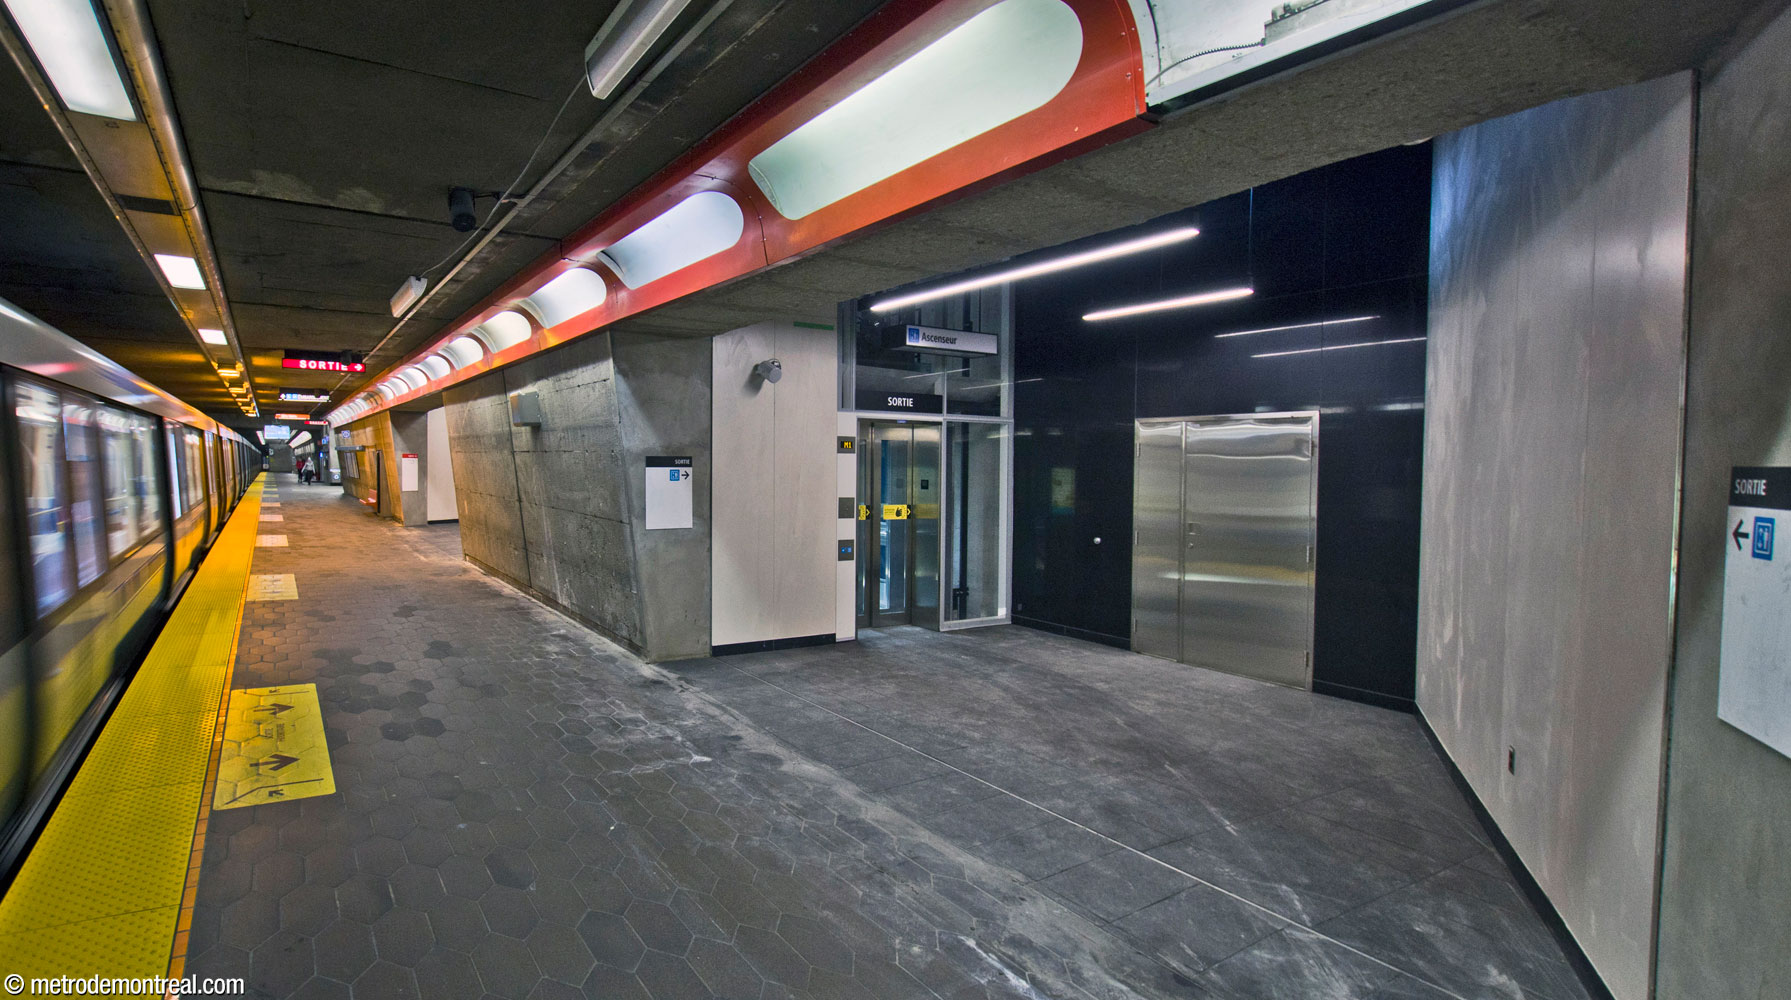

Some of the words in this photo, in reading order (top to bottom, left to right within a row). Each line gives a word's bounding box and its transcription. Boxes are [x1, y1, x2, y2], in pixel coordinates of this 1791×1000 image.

[921, 332, 957, 345] Ascenseur
[887, 396, 914, 408] SORTIE
[1734, 479, 1767, 496] SORTIE
